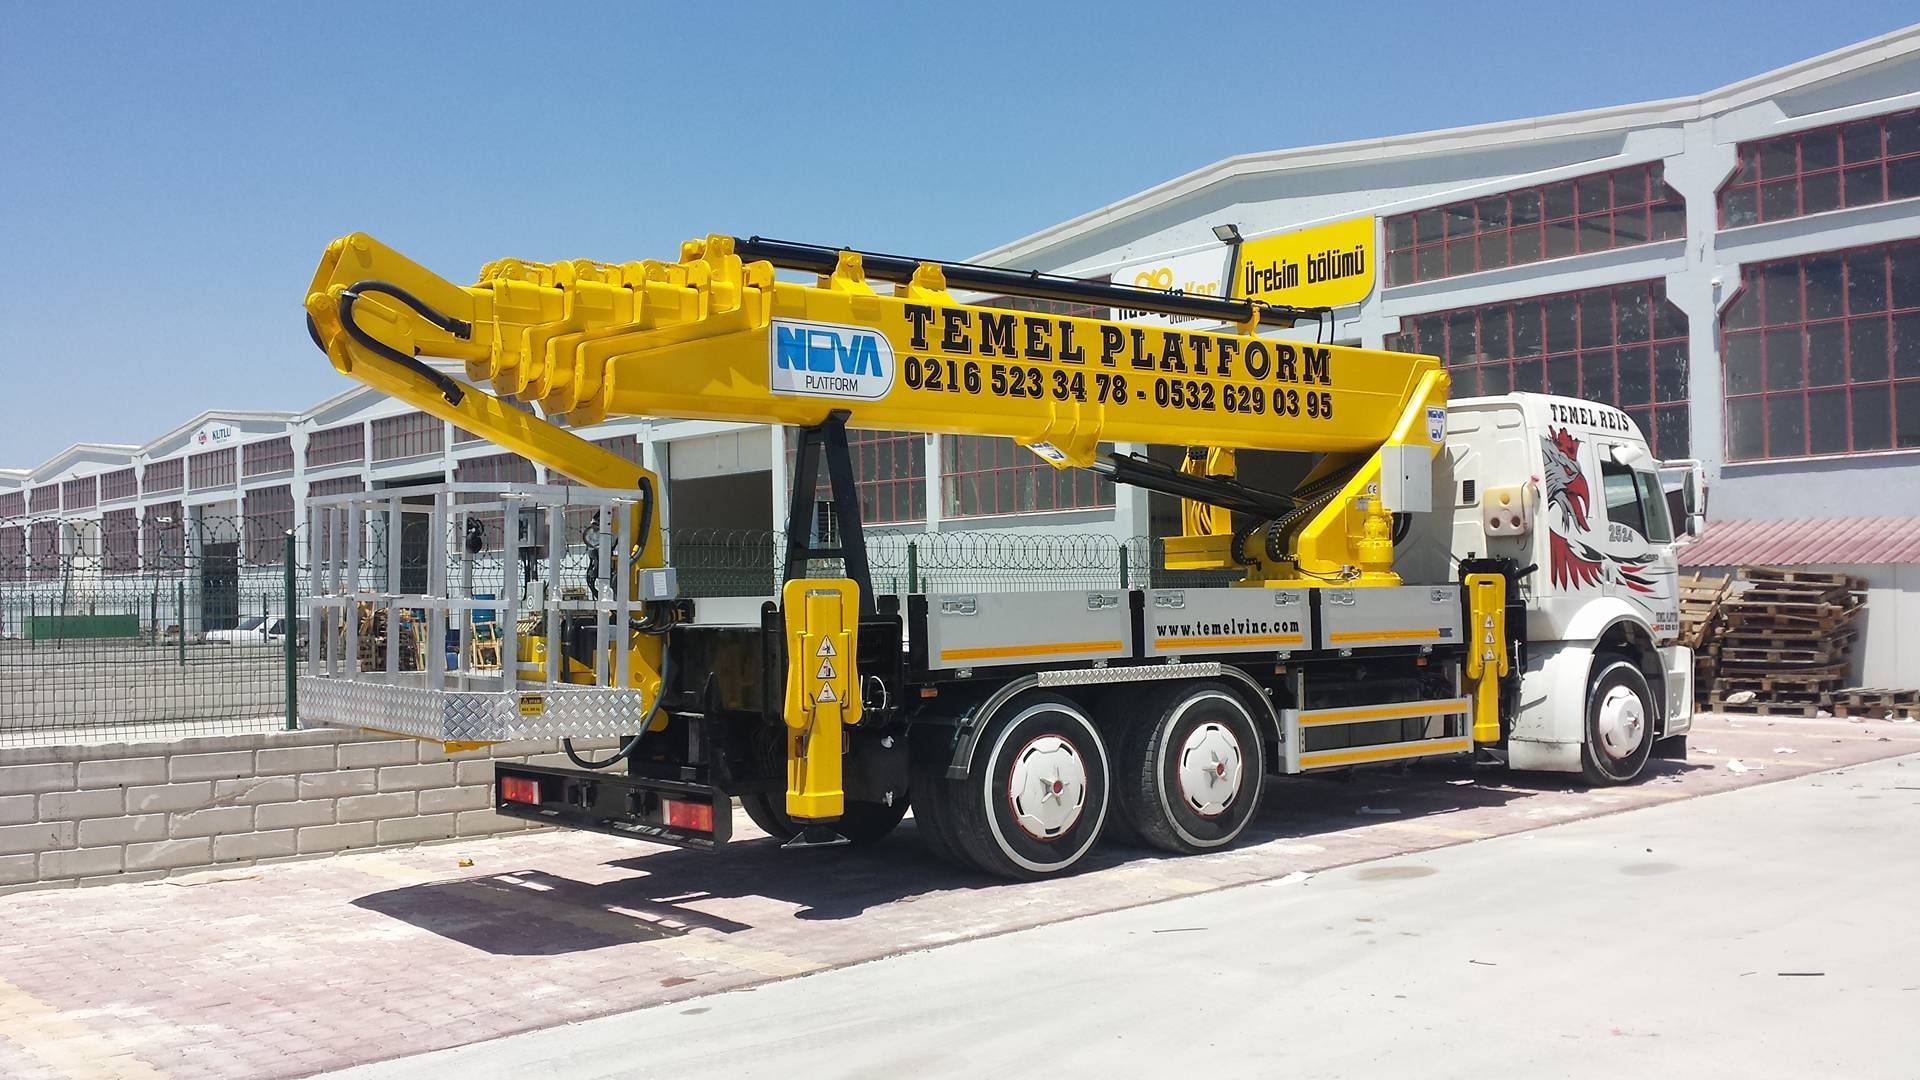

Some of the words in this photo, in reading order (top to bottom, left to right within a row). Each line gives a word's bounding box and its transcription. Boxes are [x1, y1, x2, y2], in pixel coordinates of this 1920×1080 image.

[1245, 259, 1299, 295] Üretim
[1307, 244, 1365, 284] bölümü
[777, 326, 884, 378] NOVA
[904, 303, 1086, 365] TEMEL
[1100, 325, 1332, 386] PLATFORM
[805, 375, 858, 392] PLATFORM
[904, 356, 981, 395] 0216
[991, 364, 1044, 399] 523
[1052, 369, 1087, 403] 34
[1095, 373, 1129, 405] 78
[1154, 377, 1216, 411] 0532
[1223, 384, 1266, 415] 629
[1272, 388, 1300, 417] 03
[1307, 391, 1333, 420] 95
[1550, 403, 1597, 427] TEMEL
[1608, 524, 1634, 543] 2524
[1156, 618, 1300, 637] www.temelvinc.com
